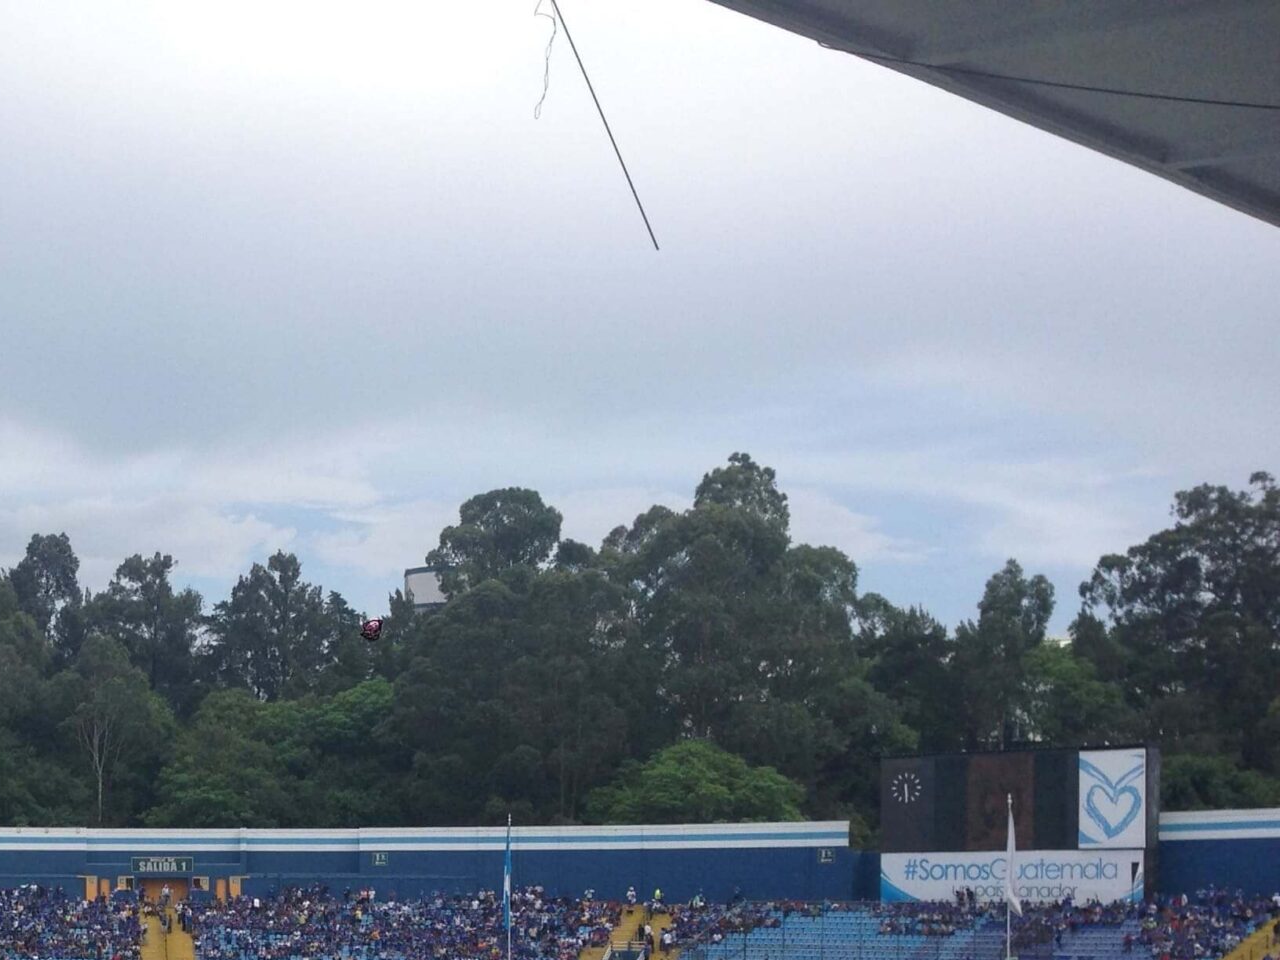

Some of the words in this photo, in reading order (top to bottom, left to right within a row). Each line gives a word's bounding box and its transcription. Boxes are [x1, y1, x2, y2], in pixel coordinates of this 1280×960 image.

[139, 861, 178, 872] SALIDA
[181, 861, 187, 872] 1
[1019, 881, 1078, 899] anador
